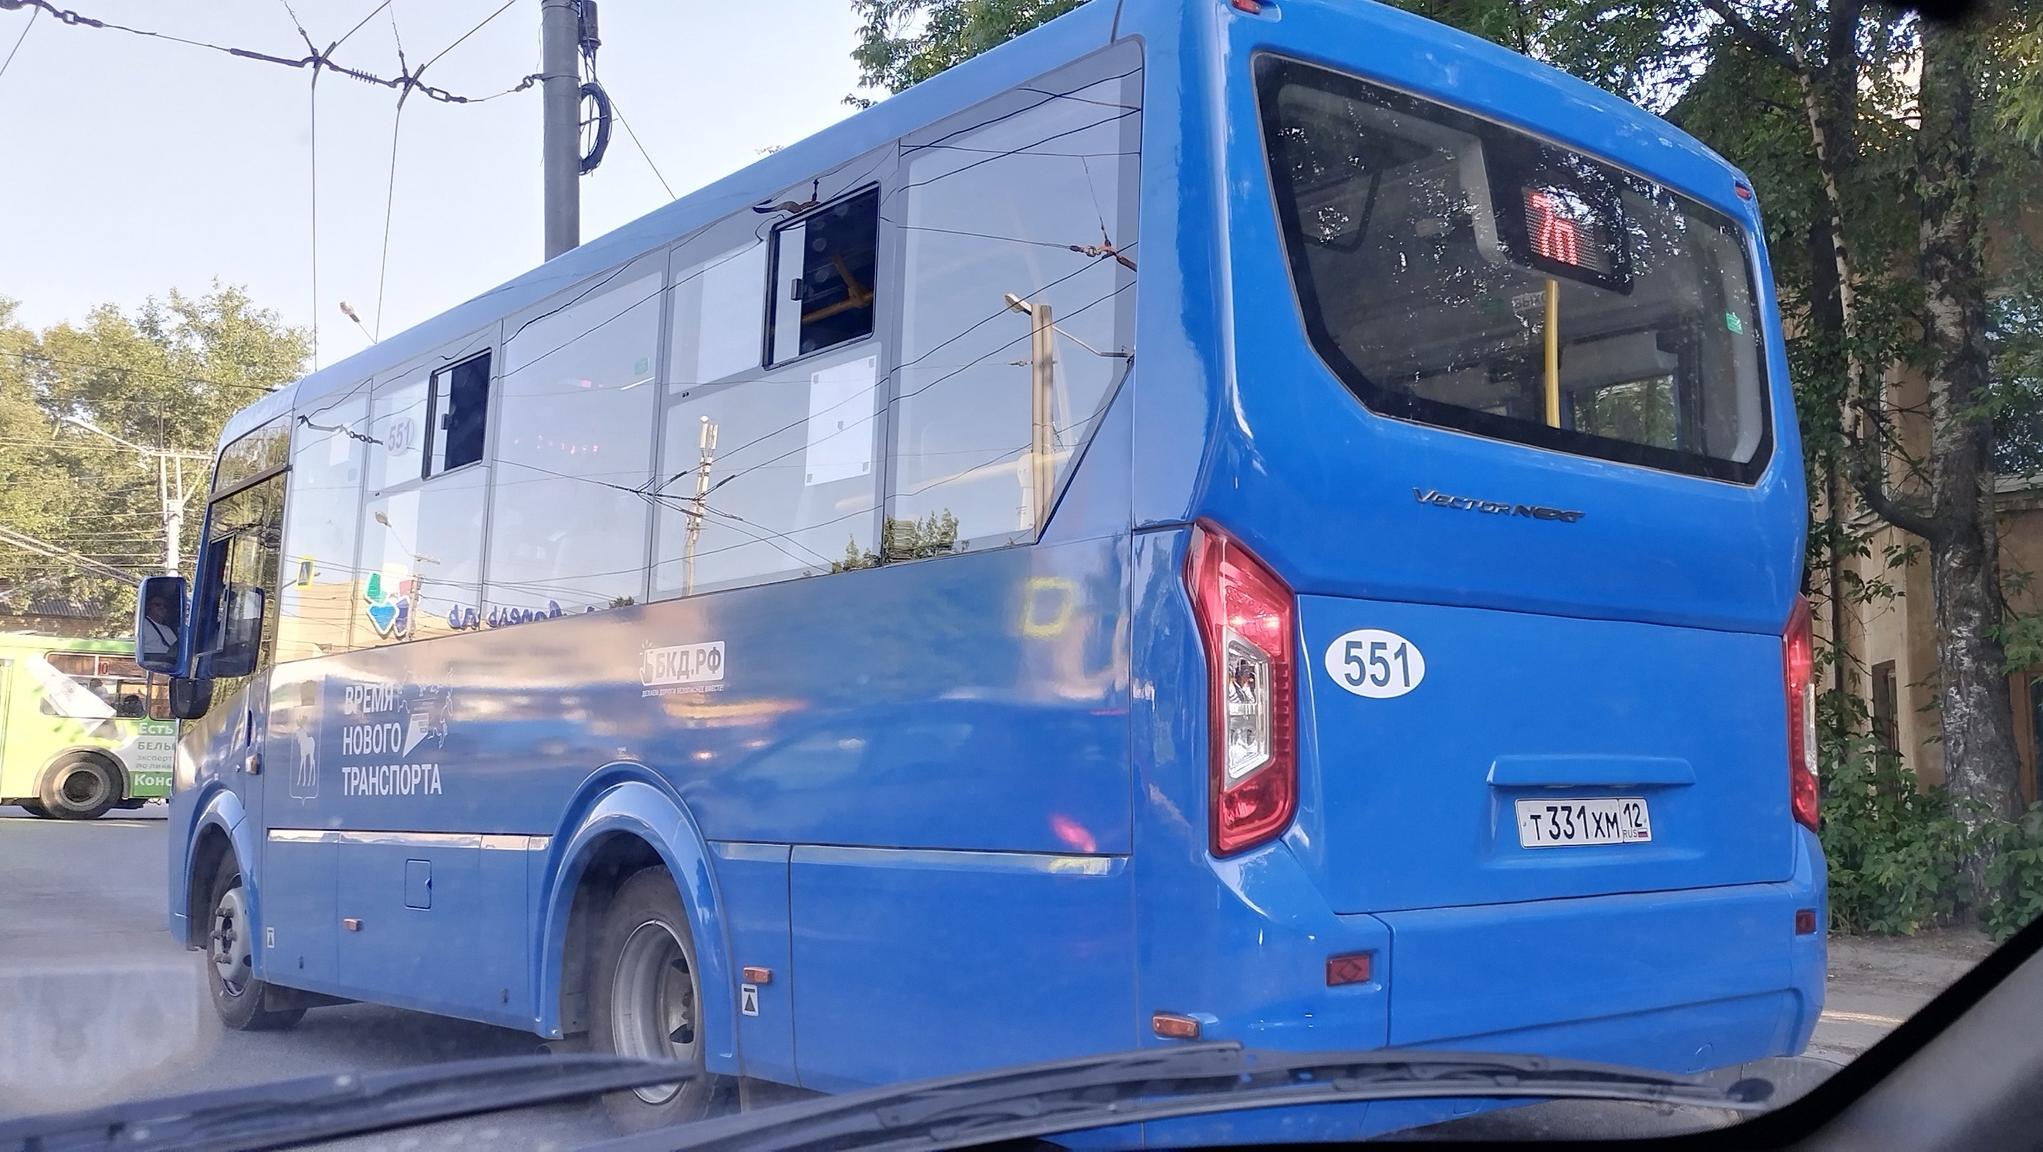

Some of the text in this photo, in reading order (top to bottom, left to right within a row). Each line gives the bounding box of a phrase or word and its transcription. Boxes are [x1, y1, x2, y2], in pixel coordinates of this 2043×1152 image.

[388, 418, 410, 452] 551
[1411, 486, 1510, 517] VECTOR
[655, 646, 722, 680] БКД.РФ
[1344, 640, 1411, 688] 551
[344, 682, 394, 715] ВРЕМЯ
[139, 722, 174, 735] Есть
[343, 722, 402, 755] НОВОГО
[341, 763, 443, 796] ТРАНСПОРТА
[1530, 803, 1643, 841] Т331ХМ 12
[1623, 829, 1638, 838] RUS
